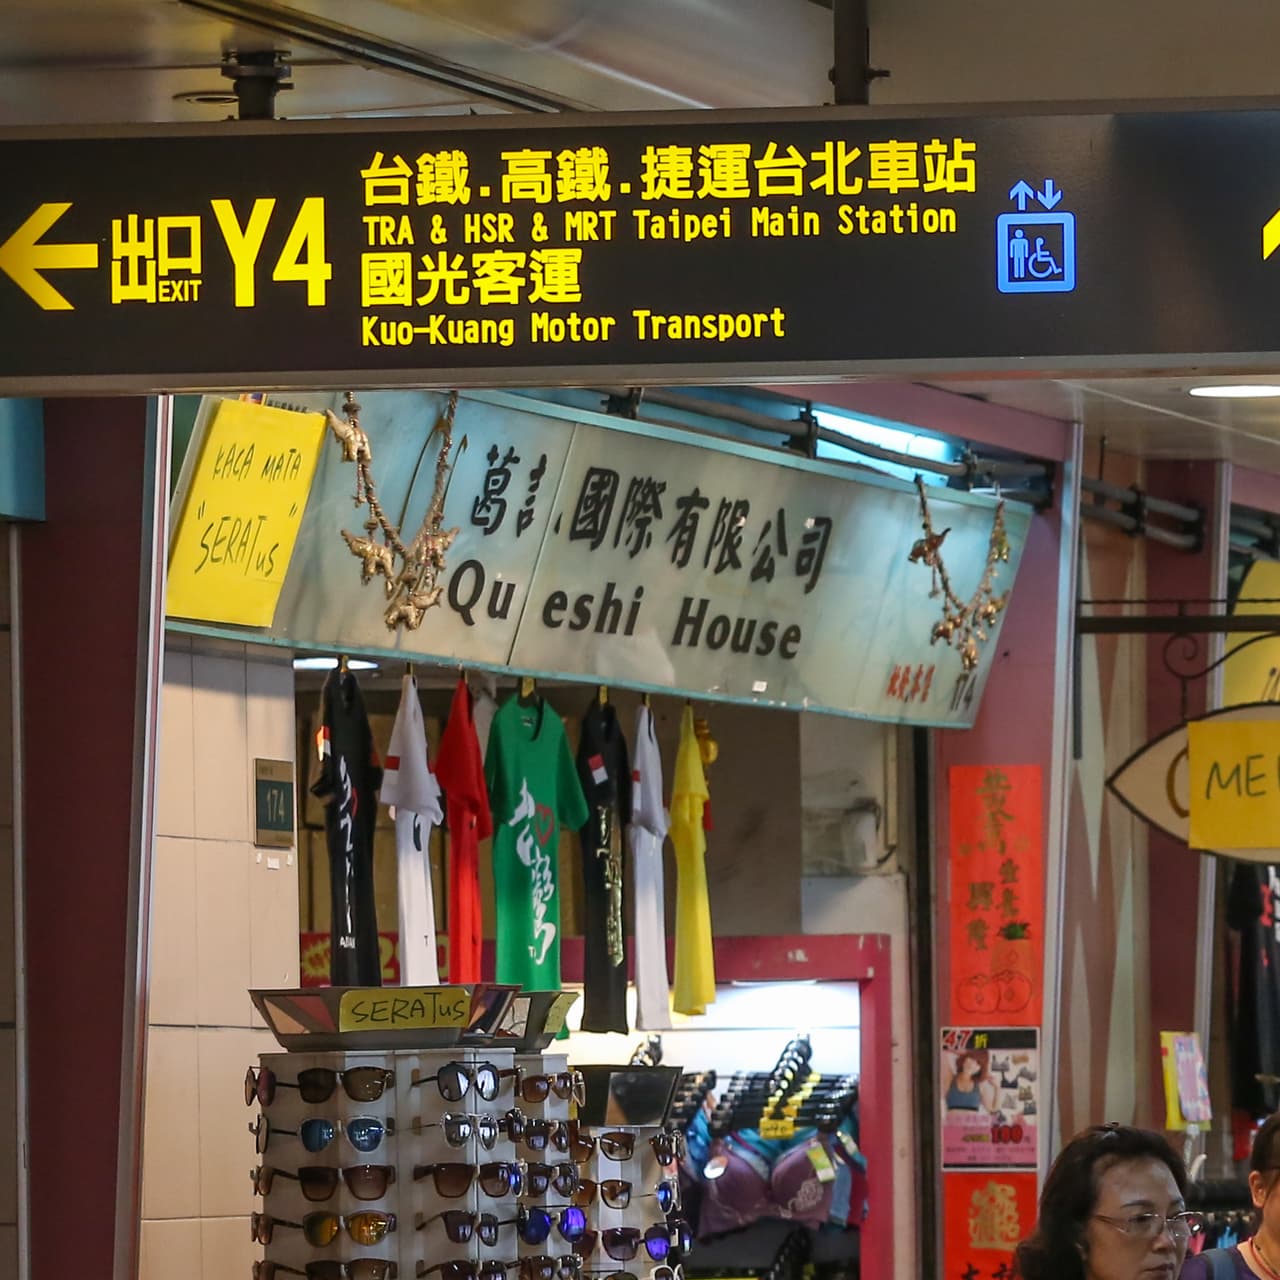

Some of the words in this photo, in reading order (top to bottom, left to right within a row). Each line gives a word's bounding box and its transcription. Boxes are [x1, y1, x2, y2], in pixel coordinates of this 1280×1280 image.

[363, 215, 415, 245] TRA
[431, 214, 448, 244] &
[465, 212, 515, 243] HSR
[532, 211, 549, 242] &
[564, 211, 617, 241] MRT
[633, 207, 731, 241] Taipei
[752, 205, 819, 236] Main
[838, 202, 956, 235] Station
[112, 214, 202, 304] 出口
[211, 196, 332, 307] Y4
[159, 280, 203, 303] EXIT
[362, 248, 582, 308] 國光客運
[363, 315, 514, 347] Kuo-Kuang
[532, 312, 616, 342] Motor
[632, 307, 785, 342] Transport
[212, 443, 256, 481] KACA
[260, 447, 302, 481] MATA
[671, 597, 802, 660] House
[266, 787, 285, 824] 174
[943, 1030, 974, 1050] 47
